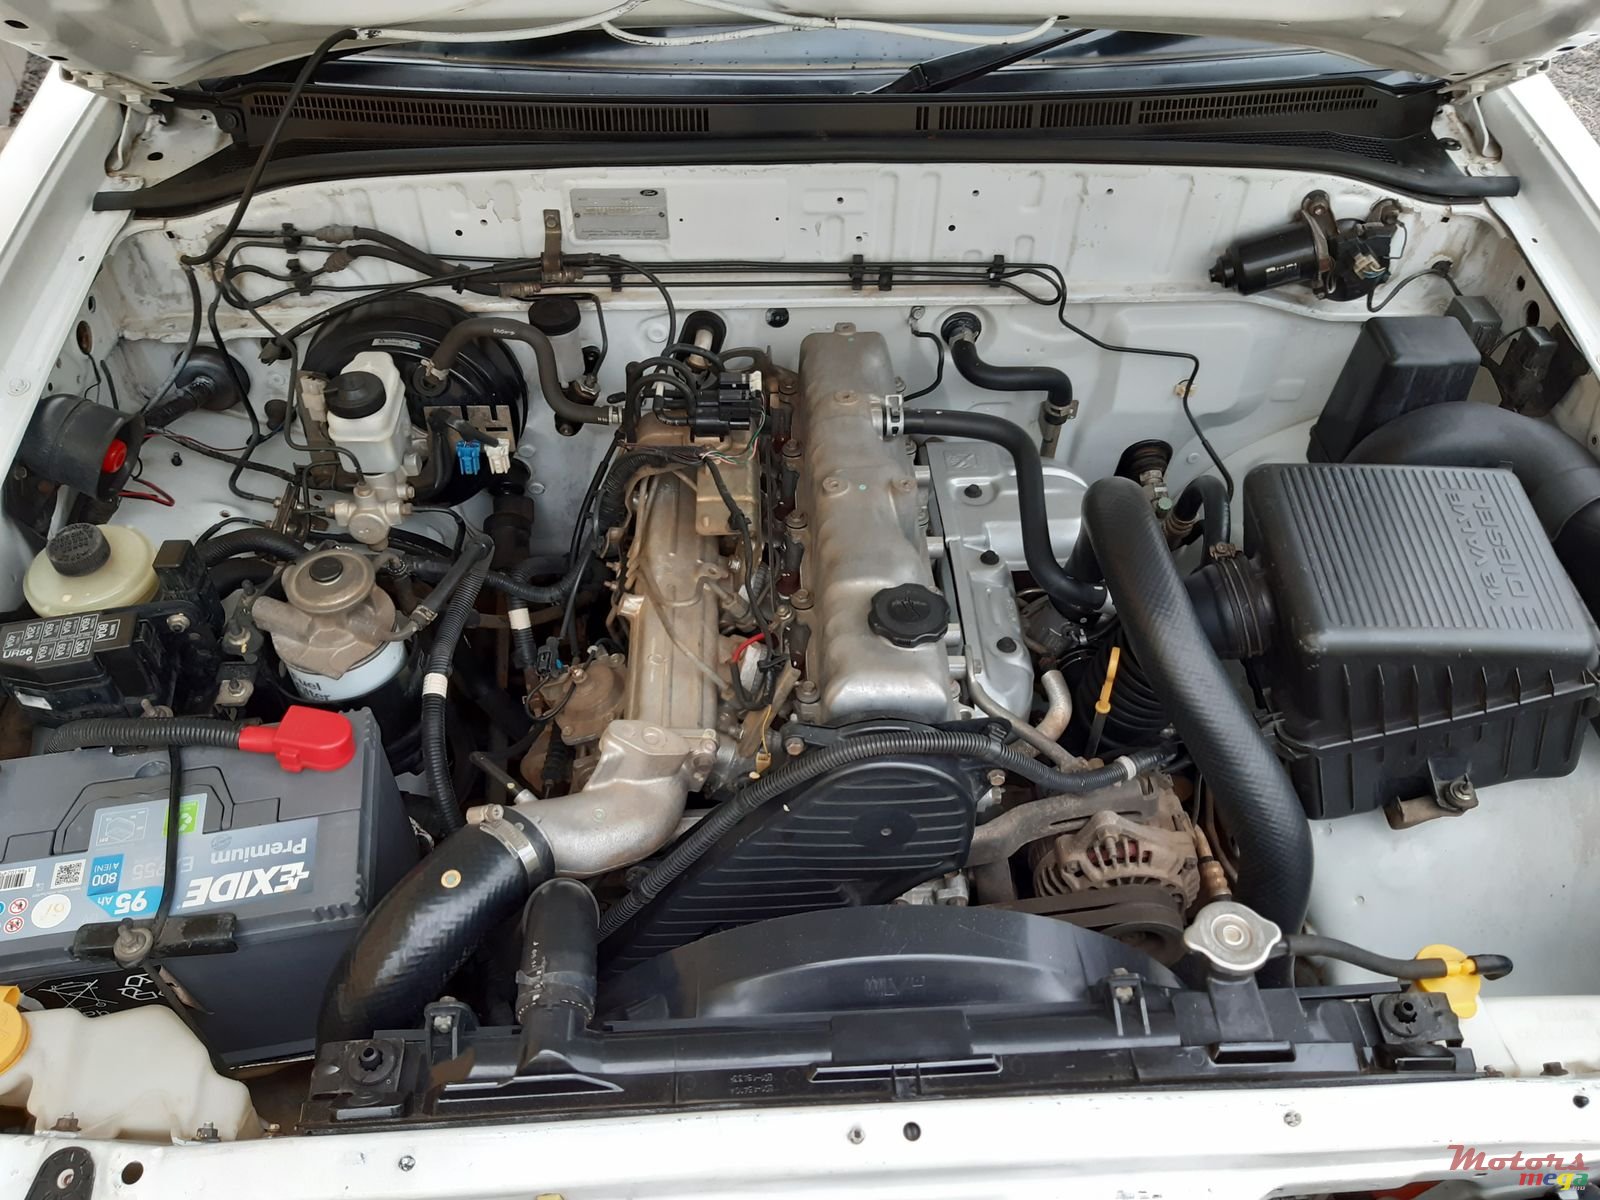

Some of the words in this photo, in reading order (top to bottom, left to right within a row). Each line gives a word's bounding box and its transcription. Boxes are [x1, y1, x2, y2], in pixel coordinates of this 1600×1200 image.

[1444, 492, 1491, 567] VALVE
[1472, 494, 1530, 599] DIESEL
[1480, 572, 1502, 600] 12
[211, 838, 307, 865] Premium
[92, 872, 118, 887] 800
[182, 861, 310, 908] EXIDE
[97, 897, 114, 907] Ah
[114, 890, 148, 915] 95
